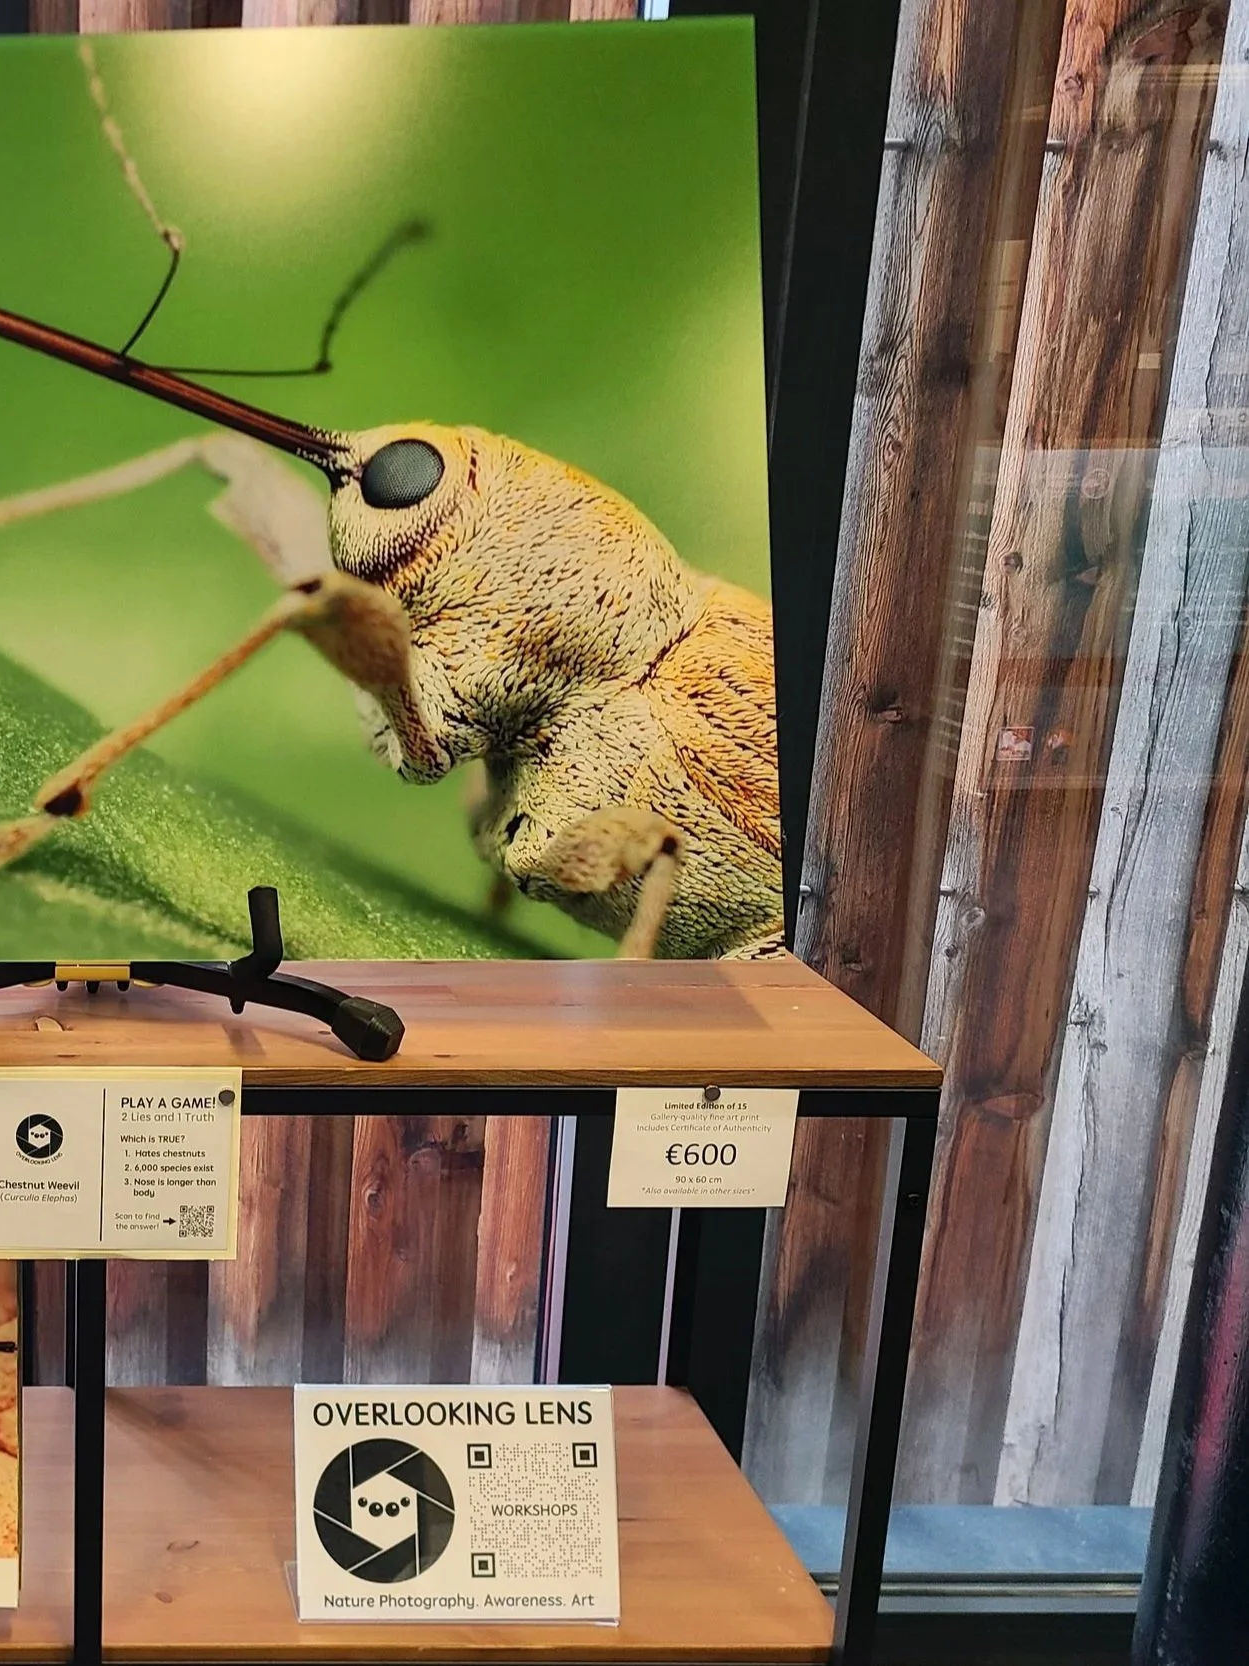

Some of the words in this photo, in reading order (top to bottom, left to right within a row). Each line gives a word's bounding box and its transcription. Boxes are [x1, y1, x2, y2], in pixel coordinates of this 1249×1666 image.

[121, 1097, 154, 1109] PLAY
[158, 1097, 167, 1109] A
[171, 1096, 216, 1109] GAME!
[664, 1102, 694, 1110] Limited
[696, 1102, 725, 1110] Edition
[726, 1102, 736, 1110] of
[121, 1112, 128, 1122] 2
[131, 1112, 151, 1122] Lies
[154, 1112, 175, 1122] and
[185, 1112, 215, 1122] Truth
[650, 1113, 707, 1122] Gallery-quality
[709, 1112, 725, 1121] fine
[740, 1113, 760, 1122] print
[636, 1124, 669, 1132] Includes
[670, 1124, 711, 1132] Certificate
[713, 1124, 722, 1132] of
[722, 1124, 772, 1133] Authenticity
[120, 1135, 146, 1143] Which
[148, 1135, 156, 1143] is
[158, 1135, 185, 1143] TRUE?
[125, 1149, 130, 1157] 1.
[135, 1149, 160, 1158] Hates
[163, 1149, 206, 1158] chestnuts
[665, 1143, 737, 1166] €600
[124, 1164, 132, 1172] 2.
[134, 1164, 158, 1173] 6,000
[160, 1164, 191, 1173] species
[193, 1164, 214, 1172] exist
[47, 1181, 80, 1190] Weevil
[124, 1178, 132, 1186] 3.
[134, 1178, 156, 1186] Nose
[158, 1178, 165, 1186] is
[167, 1178, 193, 1187] longer
[196, 1178, 217, 1186] than
[133, 1188, 155, 1198] body
[663, 1186, 699, 1195] available
[700, 1187, 708, 1195] in
[710, 1187, 731, 1195] other
[0, 1192, 40, 1202] (Curculio
[41, 1194, 78, 1203] Elephas)
[115, 1212, 133, 1220] Scan
[145, 1212, 160, 1220] find
[313, 1402, 516, 1426] OVERLOOKING
[526, 1401, 593, 1424] LENS
[491, 1504, 578, 1516] WORKSHOPS
[324, 1594, 375, 1608] Nature
[380, 1594, 479, 1610] Photography.
[484, 1594, 566, 1607] Awareness.
[572, 1593, 595, 1606] Art
